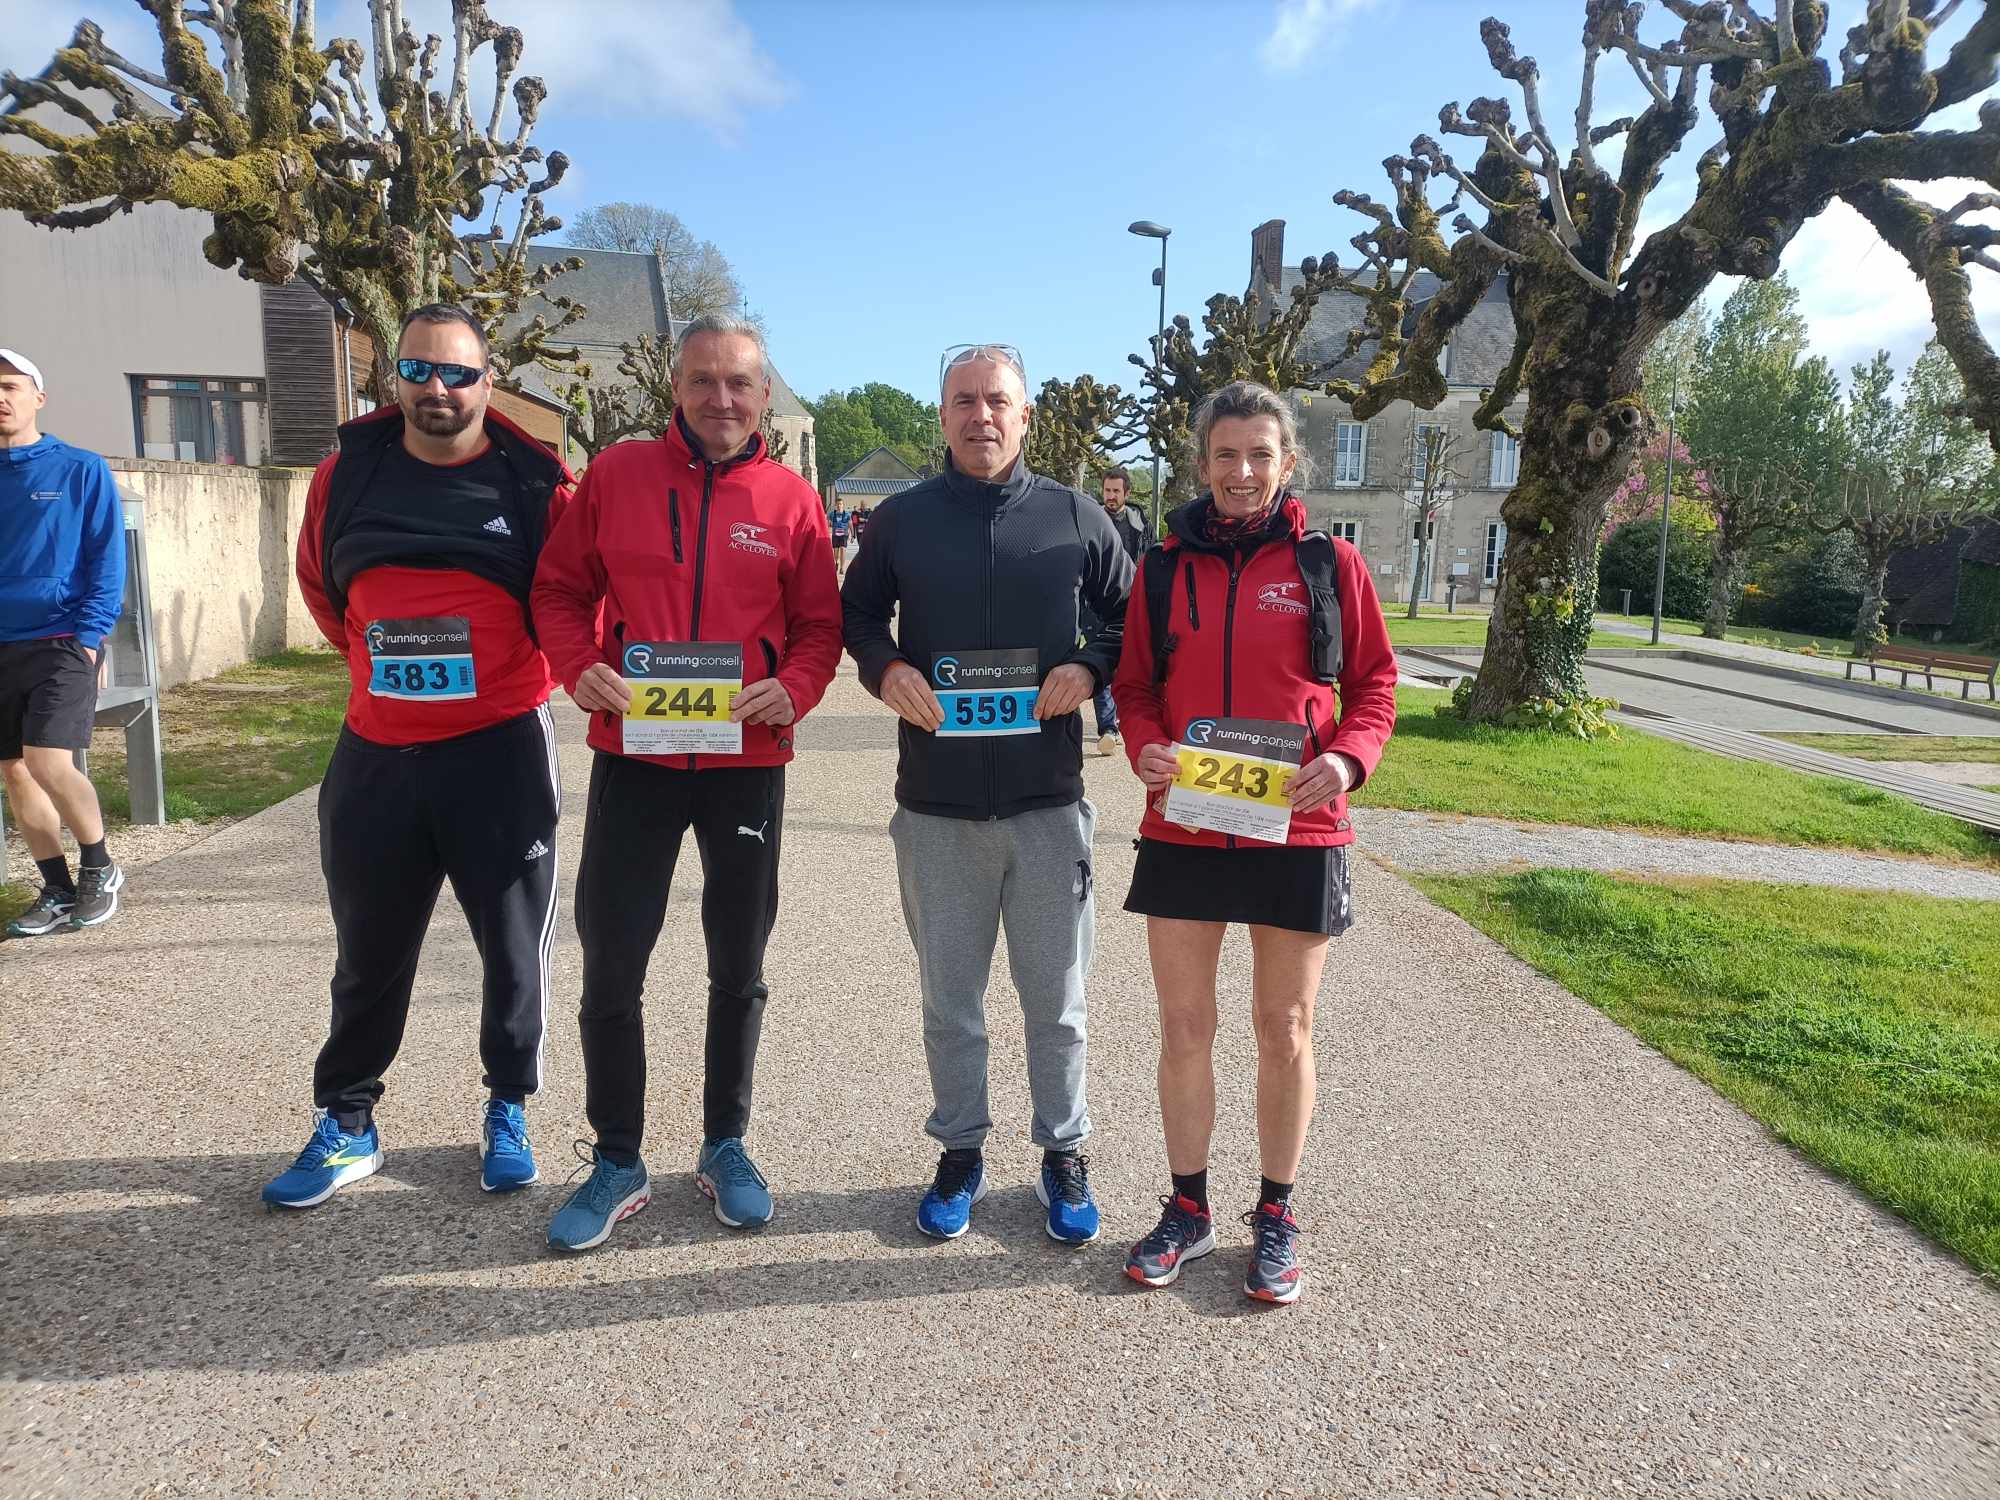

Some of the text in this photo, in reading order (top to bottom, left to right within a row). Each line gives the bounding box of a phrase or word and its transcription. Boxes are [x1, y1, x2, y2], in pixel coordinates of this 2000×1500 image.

[483, 522, 511, 535] adidas
[728, 541, 741, 550] AC
[1256, 603, 1309, 616] AC CLOYES
[384, 662, 449, 690] 583
[645, 686, 717, 717] 244
[956, 695, 1017, 725] 559
[1194, 757, 1269, 798] 243
